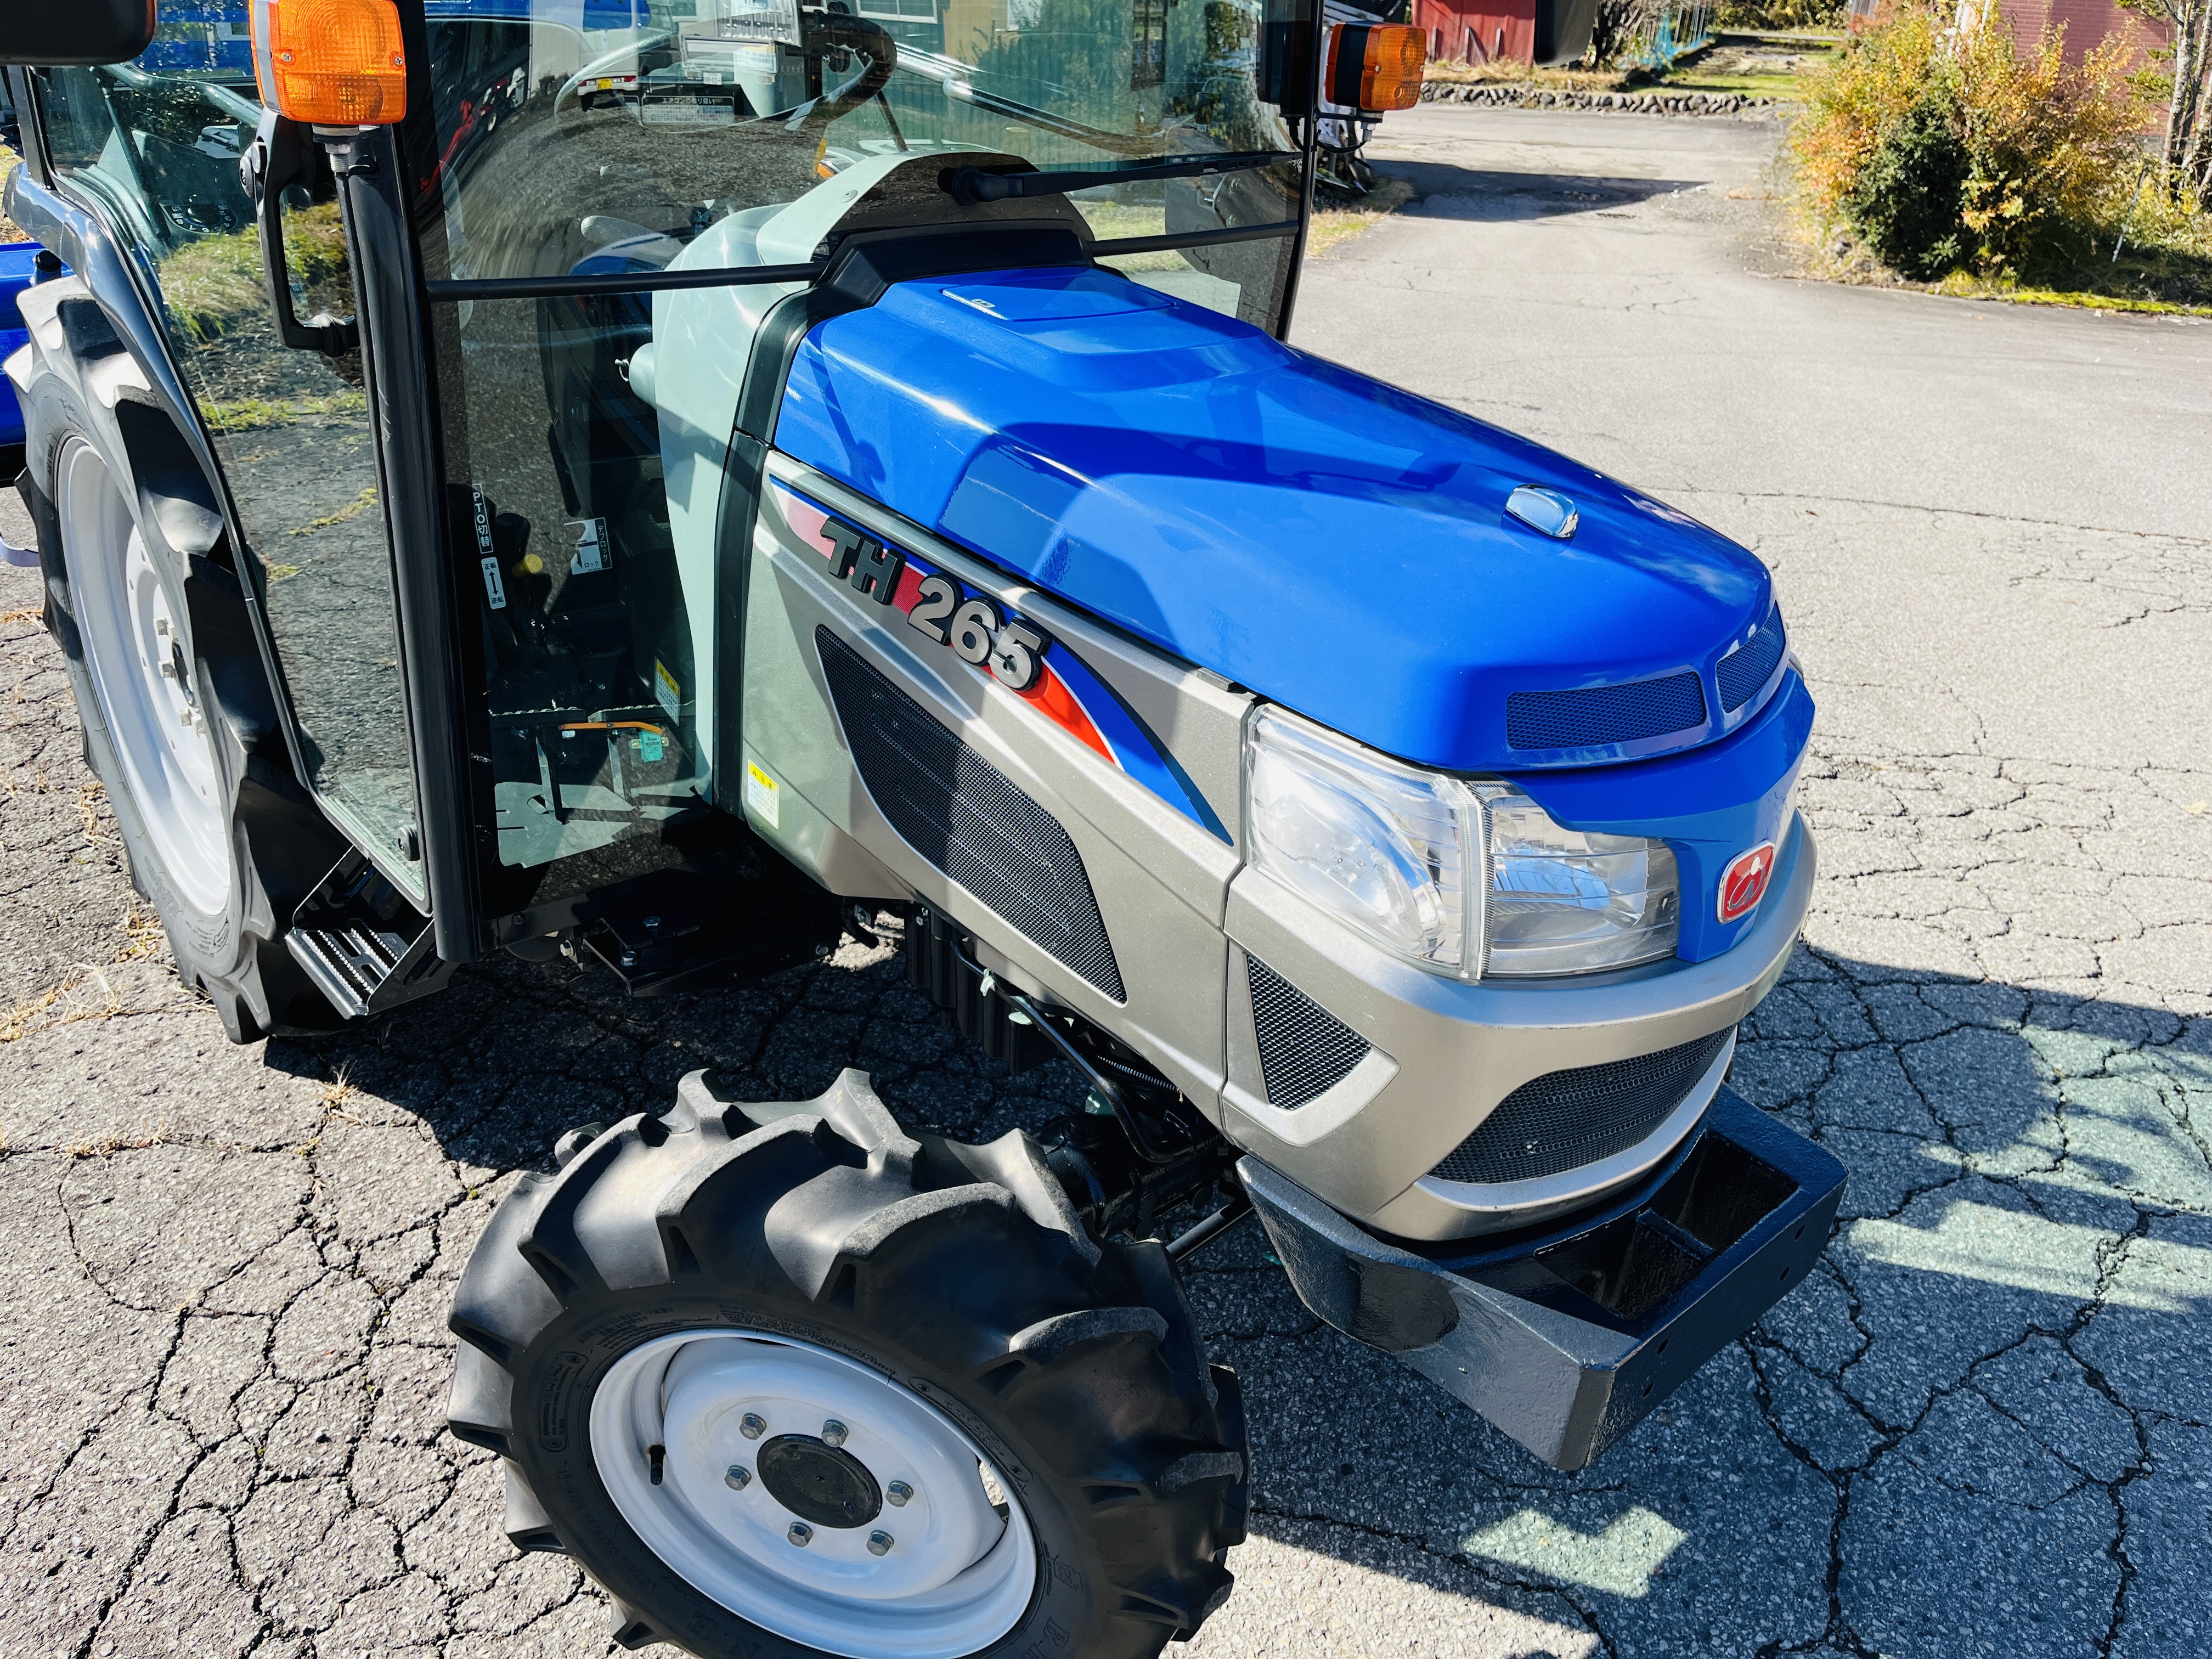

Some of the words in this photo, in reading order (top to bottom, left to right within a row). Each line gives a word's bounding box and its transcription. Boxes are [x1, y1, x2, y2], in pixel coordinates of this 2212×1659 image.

[472, 492, 490, 548] PTO切替
[821, 515, 907, 605] TH
[907, 572, 1053, 691] 265
